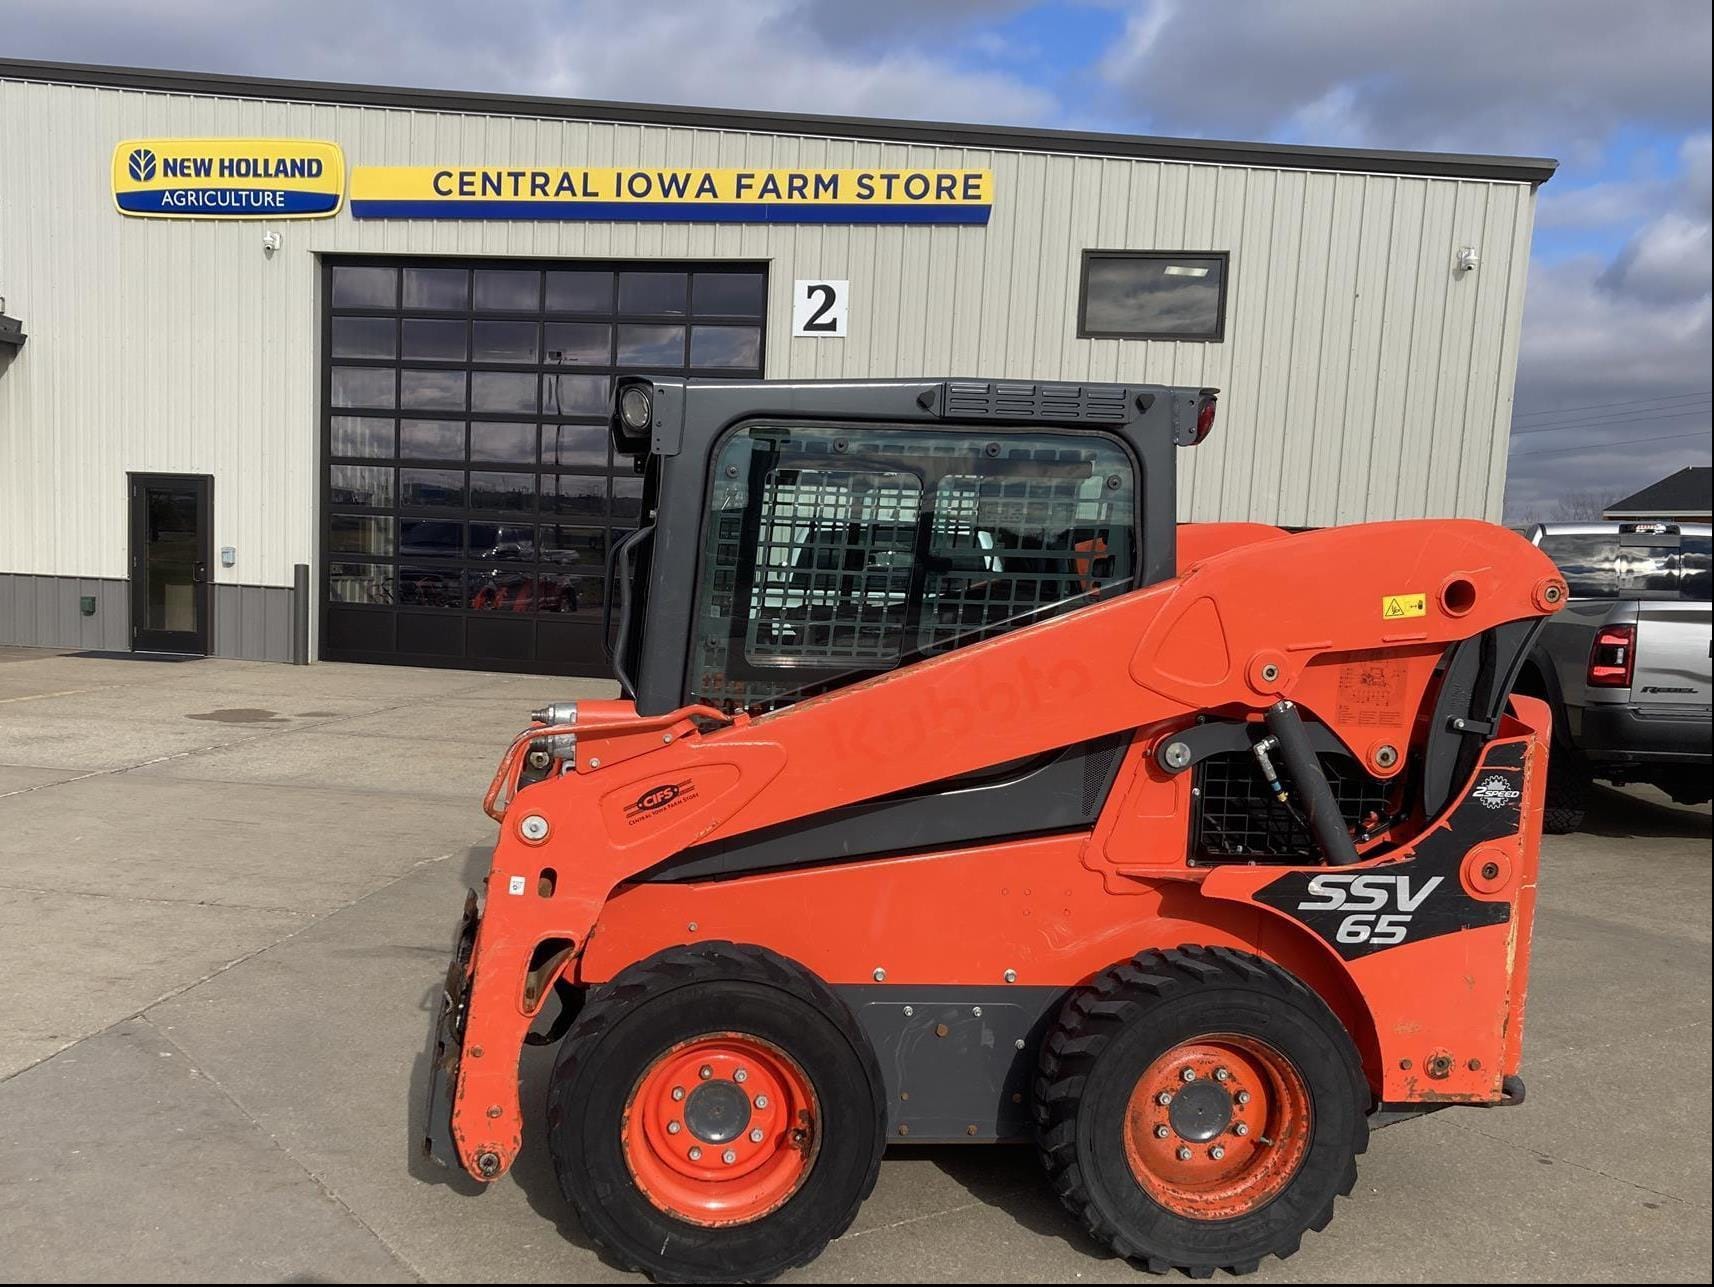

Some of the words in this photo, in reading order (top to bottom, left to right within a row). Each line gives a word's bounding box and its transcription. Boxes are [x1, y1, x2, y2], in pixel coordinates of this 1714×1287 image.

[163, 157, 213, 178] NEW
[219, 157, 323, 178] HOLLAND
[161, 190, 285, 207] AGRICULTURE
[433, 170, 599, 197] CENTRAL
[615, 171, 718, 199] IOWA
[736, 173, 839, 200] FARM
[856, 173, 982, 200] STORE
[803, 284, 838, 332] 2
[643, 788, 673, 807] CIFS
[1297, 874, 1445, 912] SSV
[1335, 914, 1412, 944] 65
